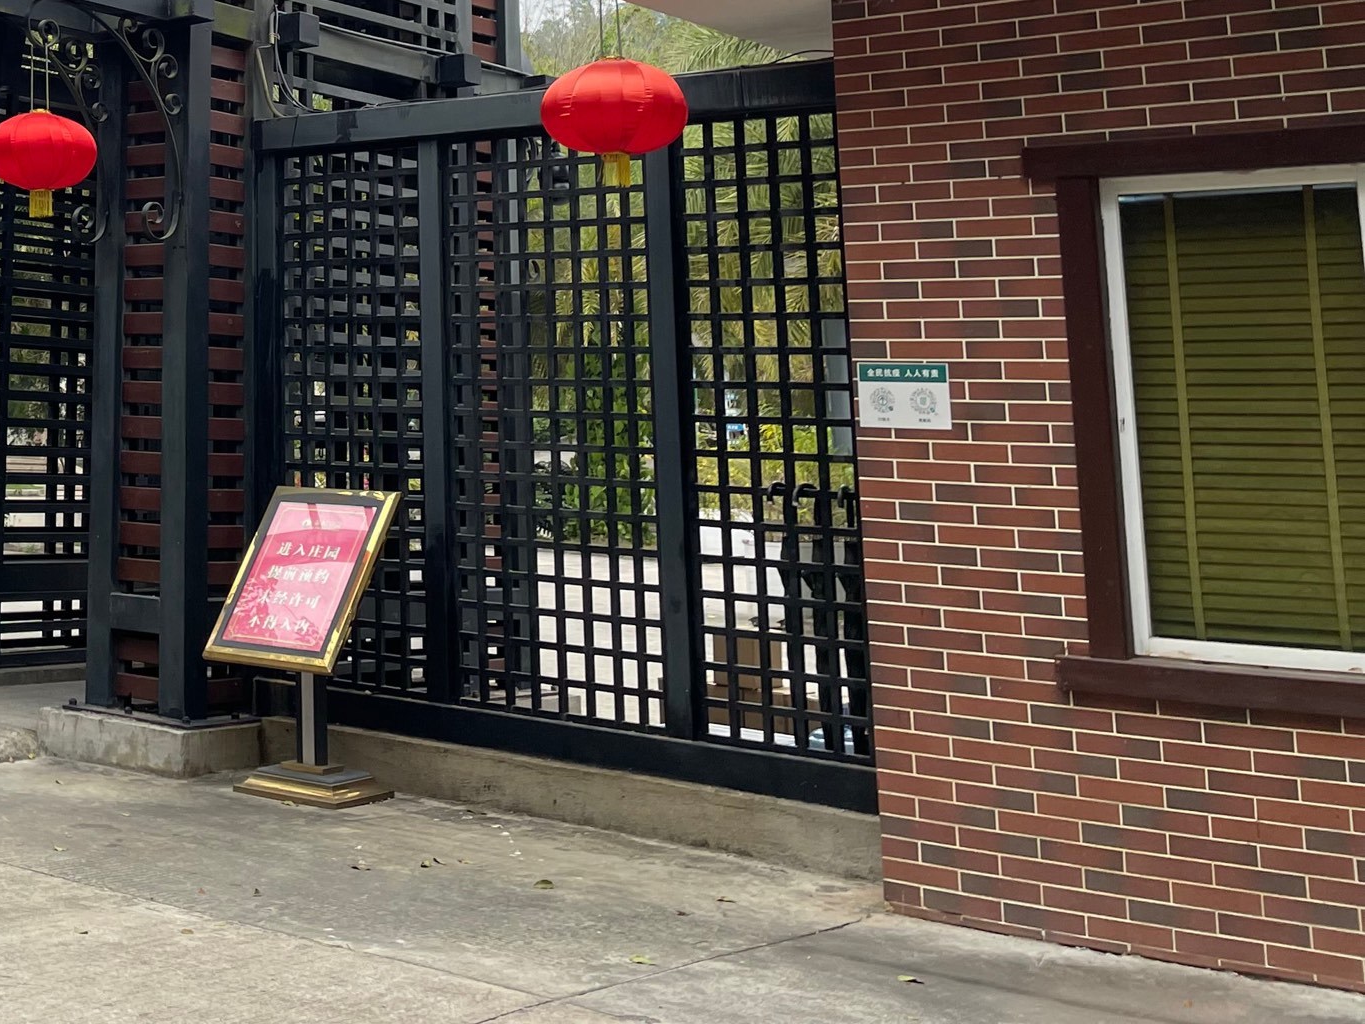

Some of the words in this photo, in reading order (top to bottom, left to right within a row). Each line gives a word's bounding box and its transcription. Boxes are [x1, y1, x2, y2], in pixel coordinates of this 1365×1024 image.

[276, 541, 341, 561] 进入庄园
[266, 565, 331, 584] 提前预约
[258, 588, 322, 609] 未经许可
[248, 615, 310, 634] 不得入内
